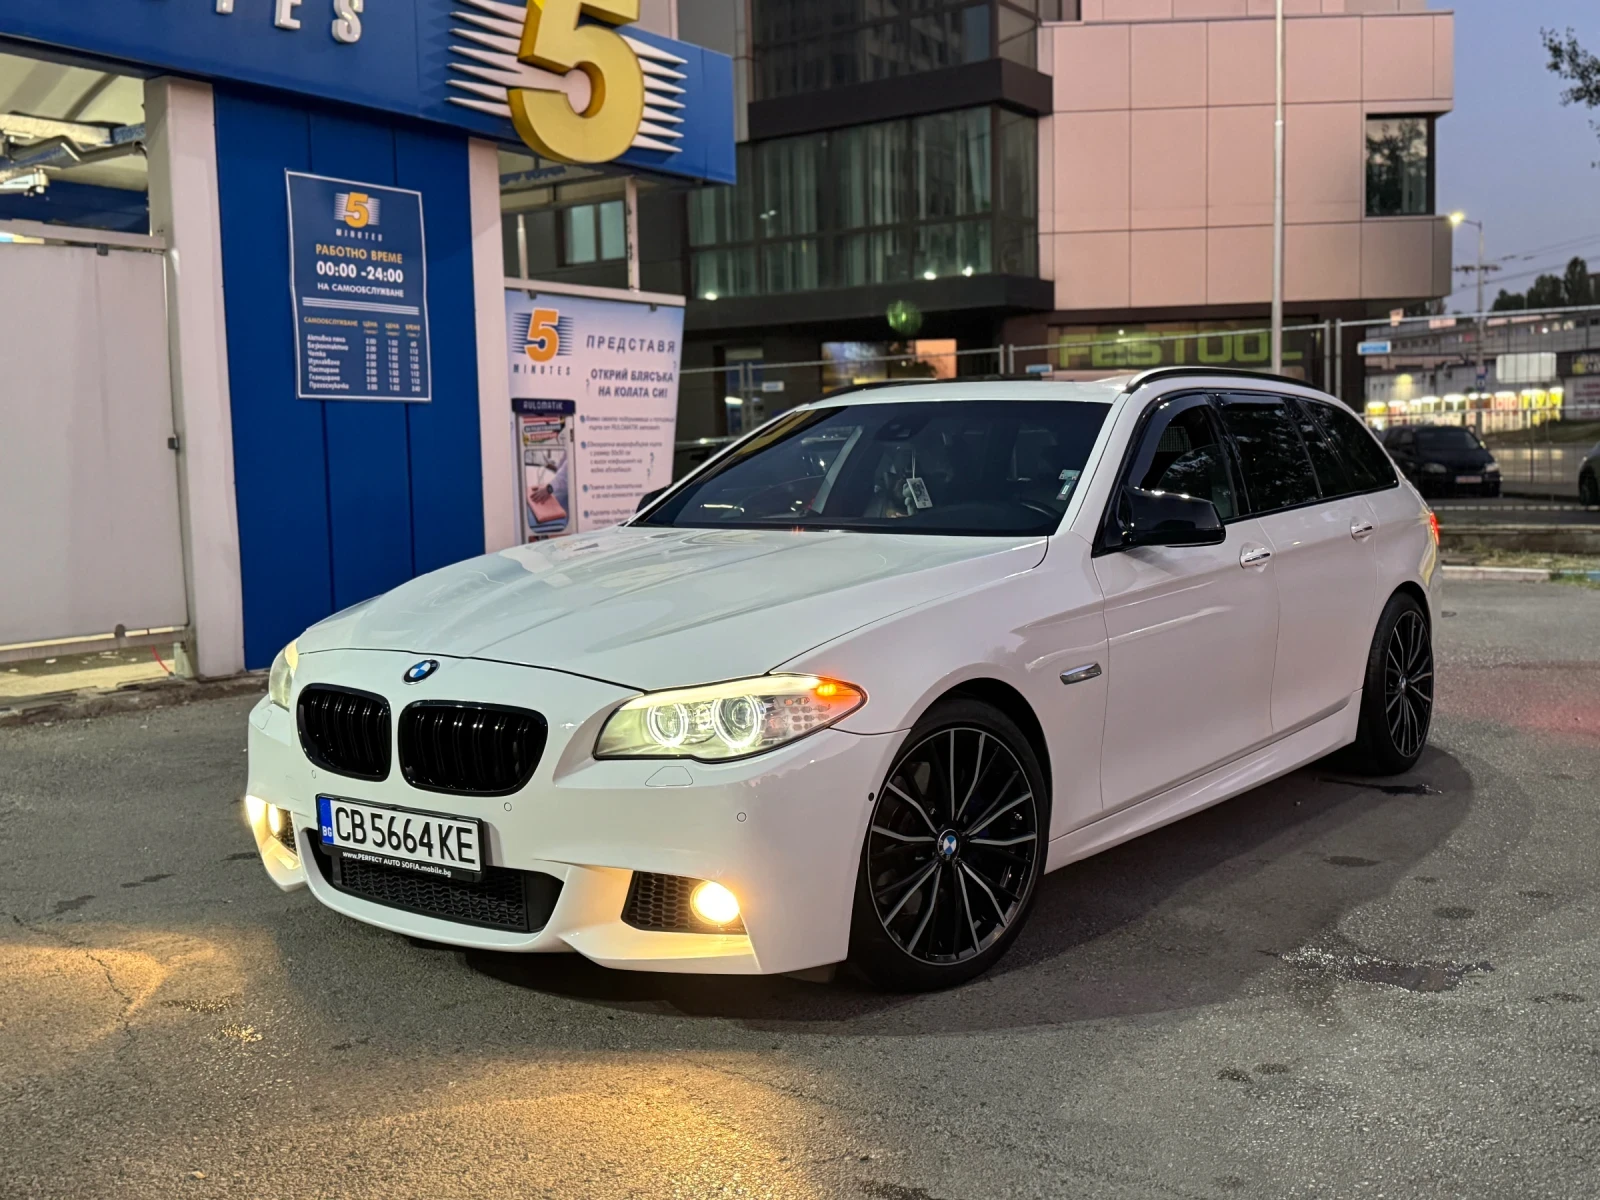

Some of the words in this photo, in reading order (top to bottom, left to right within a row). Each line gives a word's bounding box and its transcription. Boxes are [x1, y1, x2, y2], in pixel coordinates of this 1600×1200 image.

[216, 0, 363, 43] ES
[508, 0, 644, 163] 5
[344, 192, 369, 228] 5
[316, 244, 367, 260] РАБОТНО
[371, 250, 402, 264] ВРЕМЕ
[316, 261, 357, 278] 00:00
[317, 282, 330, 291] НА
[331, 284, 404, 297] САМООБСЛУЖВАНЕ
[524, 308, 560, 363] 5
[586, 335, 676, 354] ПРЕДСТАВЯ
[513, 364, 571, 376] MINUTES
[591, 367, 628, 382] ОТКРИЙ
[630, 370, 674, 382] БЛЯСЪКА
[598, 386, 611, 396] НА
[614, 386, 649, 398] КОЛАТА
[652, 388, 668, 398] СИ!
[322, 826, 333, 837] BG
[383, 858, 400, 867] AUTO
[401, 861, 452, 877] SOFIA.mobile.bg
